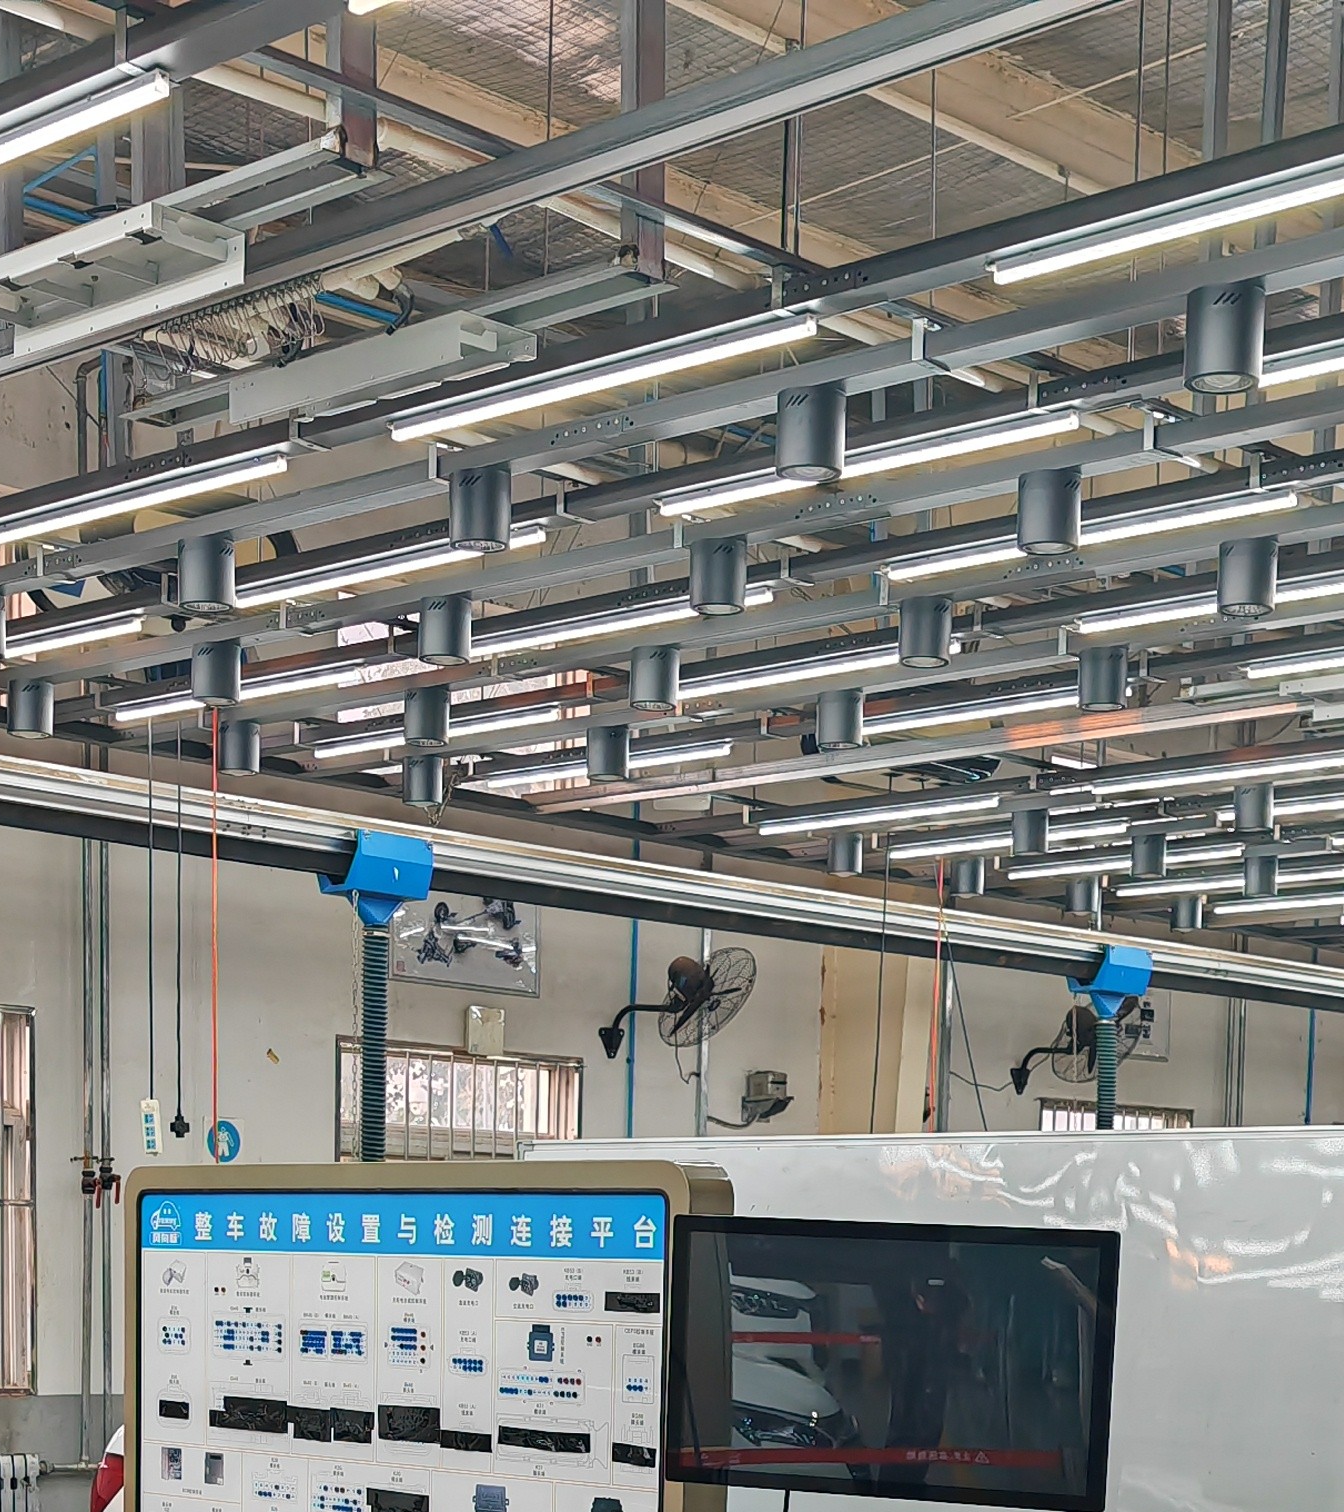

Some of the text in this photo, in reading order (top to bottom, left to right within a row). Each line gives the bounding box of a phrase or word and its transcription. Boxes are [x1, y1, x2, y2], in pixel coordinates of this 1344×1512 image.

[194, 1211, 657, 1249] 整车故障设置与检测连接平台
